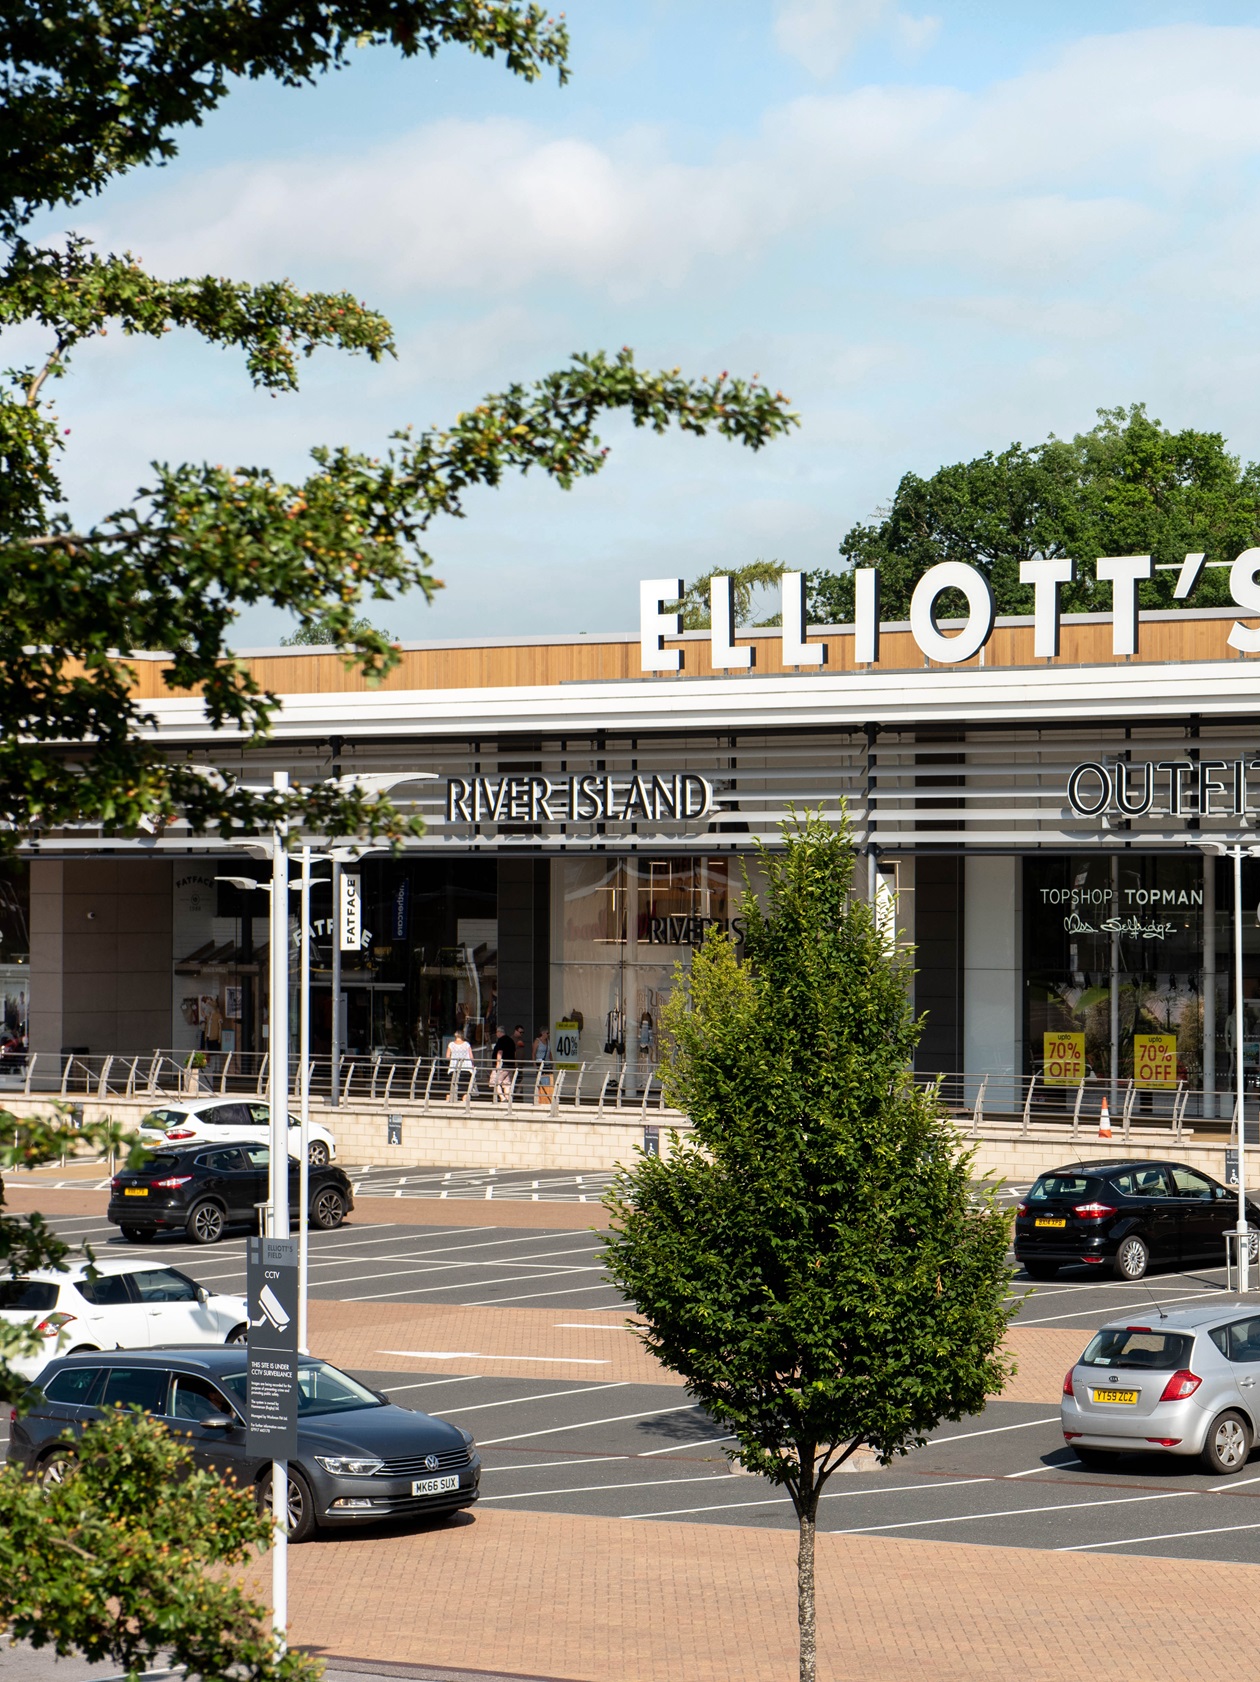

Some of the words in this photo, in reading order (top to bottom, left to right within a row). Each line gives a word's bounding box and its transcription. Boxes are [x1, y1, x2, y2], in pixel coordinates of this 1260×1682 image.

[447, 777, 554, 822] RIVER
[568, 774, 712, 822] ISLAND
[1040, 889, 1113, 904] TOPSHOP
[1124, 889, 1204, 905] TOPMAN
[346, 878, 356, 945] FATFACE
[1100, 914, 1178, 940] Selfridge
[1049, 1042, 1081, 1059] 70%
[1139, 1045, 1172, 1062] 70%
[1049, 1062, 1081, 1077] OFF
[1139, 1064, 1172, 1081] OFF
[264, 1270, 280, 1279] CCTV
[263, 1370, 293, 1378] SURVEILLANCE
[274, 1363, 290, 1371] UNDER
[1097, 1390, 1117, 1401] YT59
[1118, 1392, 1134, 1402] ZCZ
[416, 1480, 439, 1493] MK66
[440, 1477, 456, 1489] SUX
